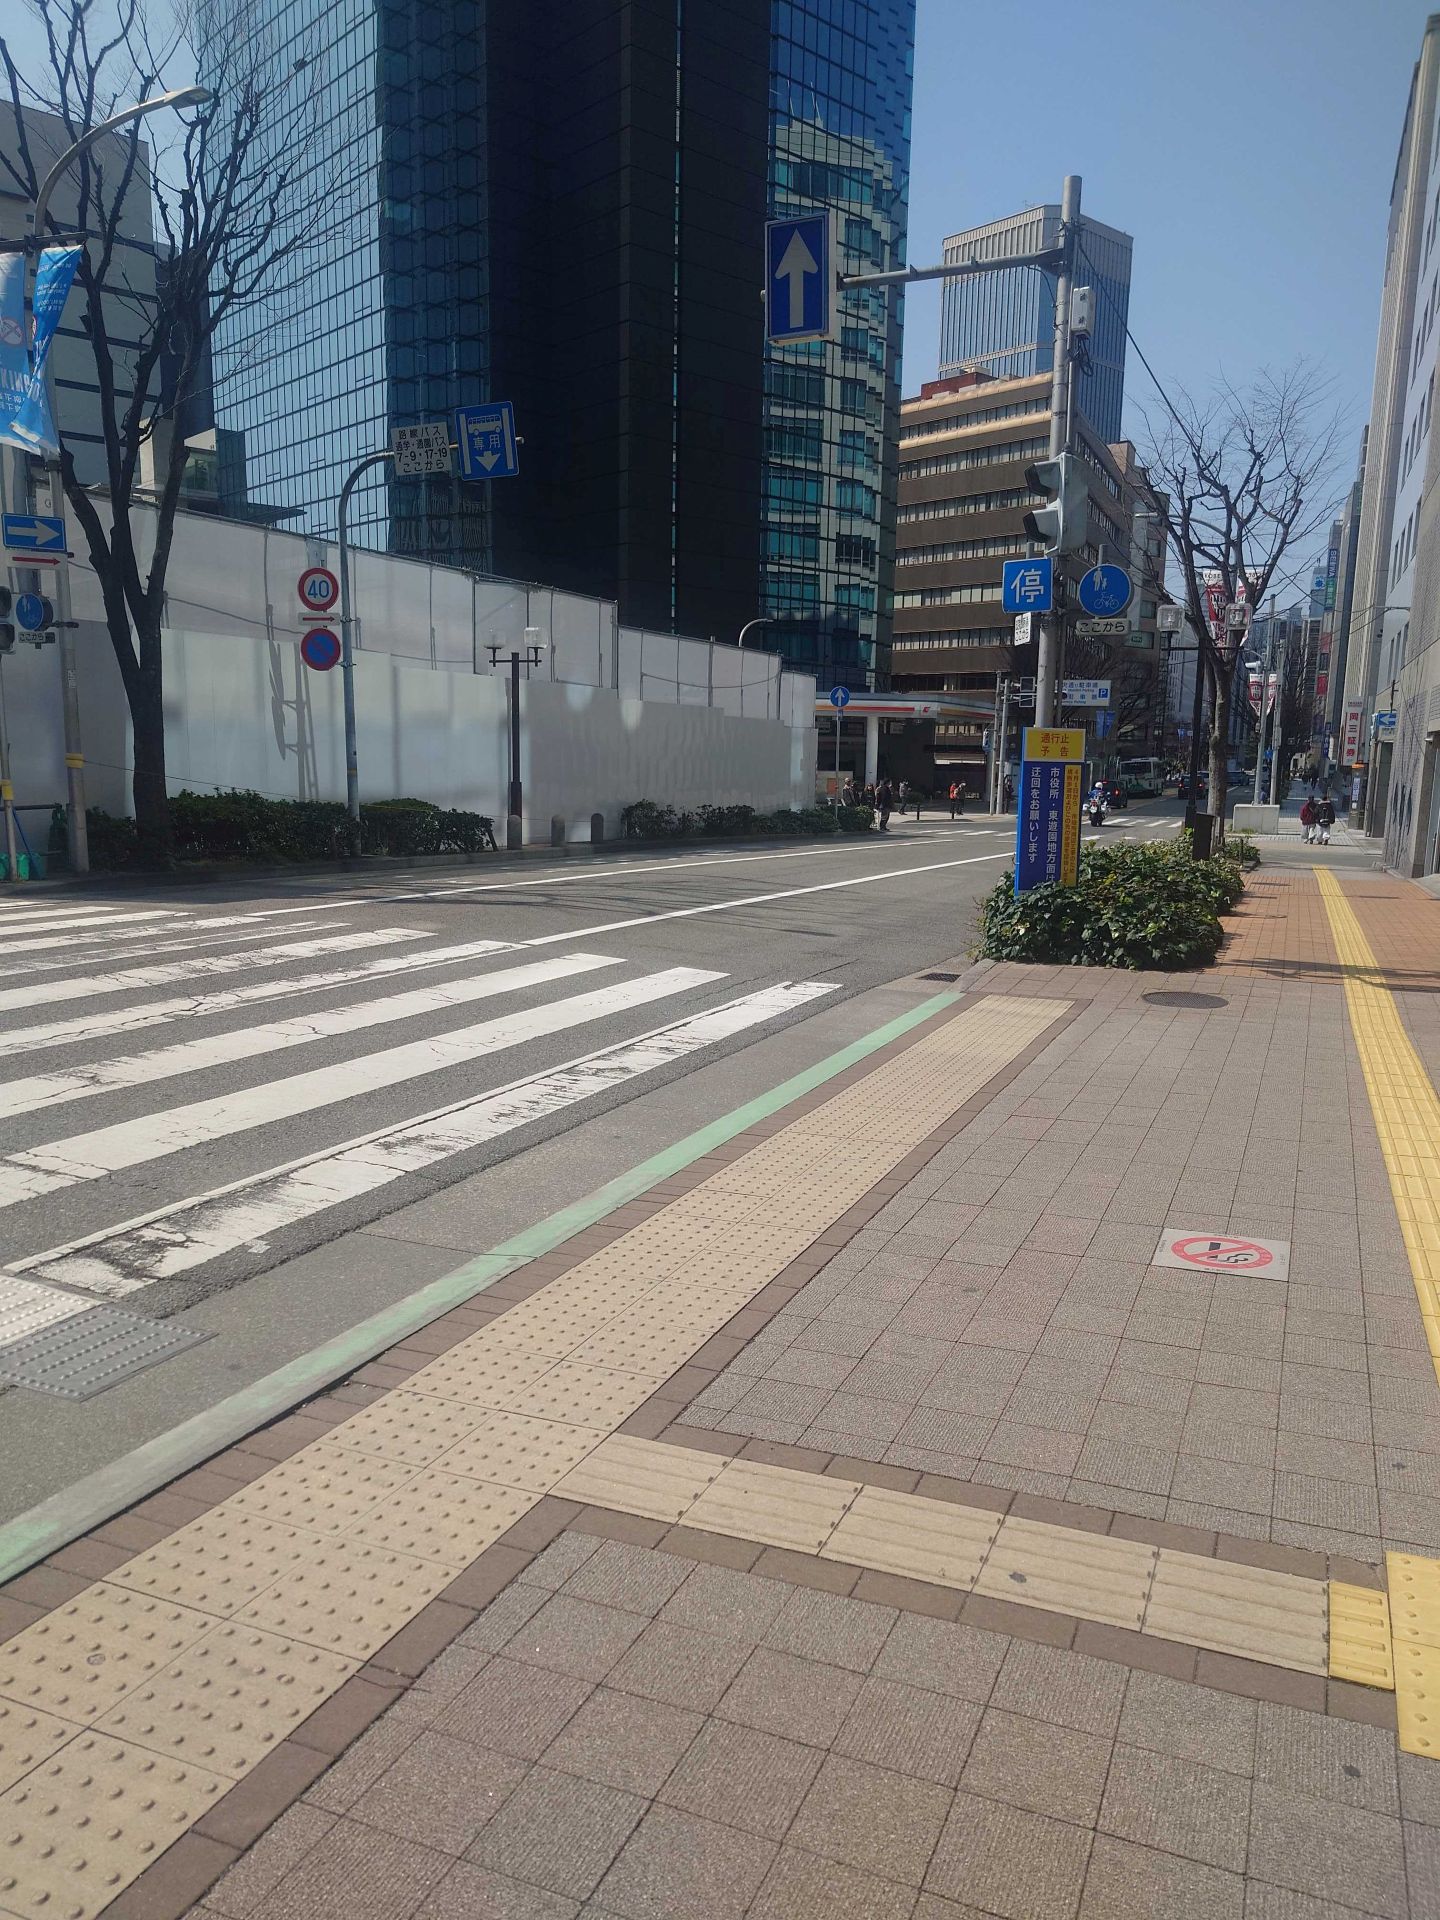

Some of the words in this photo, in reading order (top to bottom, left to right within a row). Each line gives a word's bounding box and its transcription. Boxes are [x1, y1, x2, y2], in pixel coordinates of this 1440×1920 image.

[398, 426, 441, 440] 路線バス
[473, 434, 501, 450] 専用
[403, 460, 445, 473] ここから
[307, 579, 330, 599] 40
[1010, 568, 1045, 604] 停
[1079, 621, 1126, 634] ここから
[19, 633, 44, 641] ここから
[1040, 733, 1070, 745] 通行止
[1345, 712, 1359, 758] 岡三証券
[1040, 746, 1070, 757] 予告
[1028, 767, 1041, 863] 迂回をお願いします
